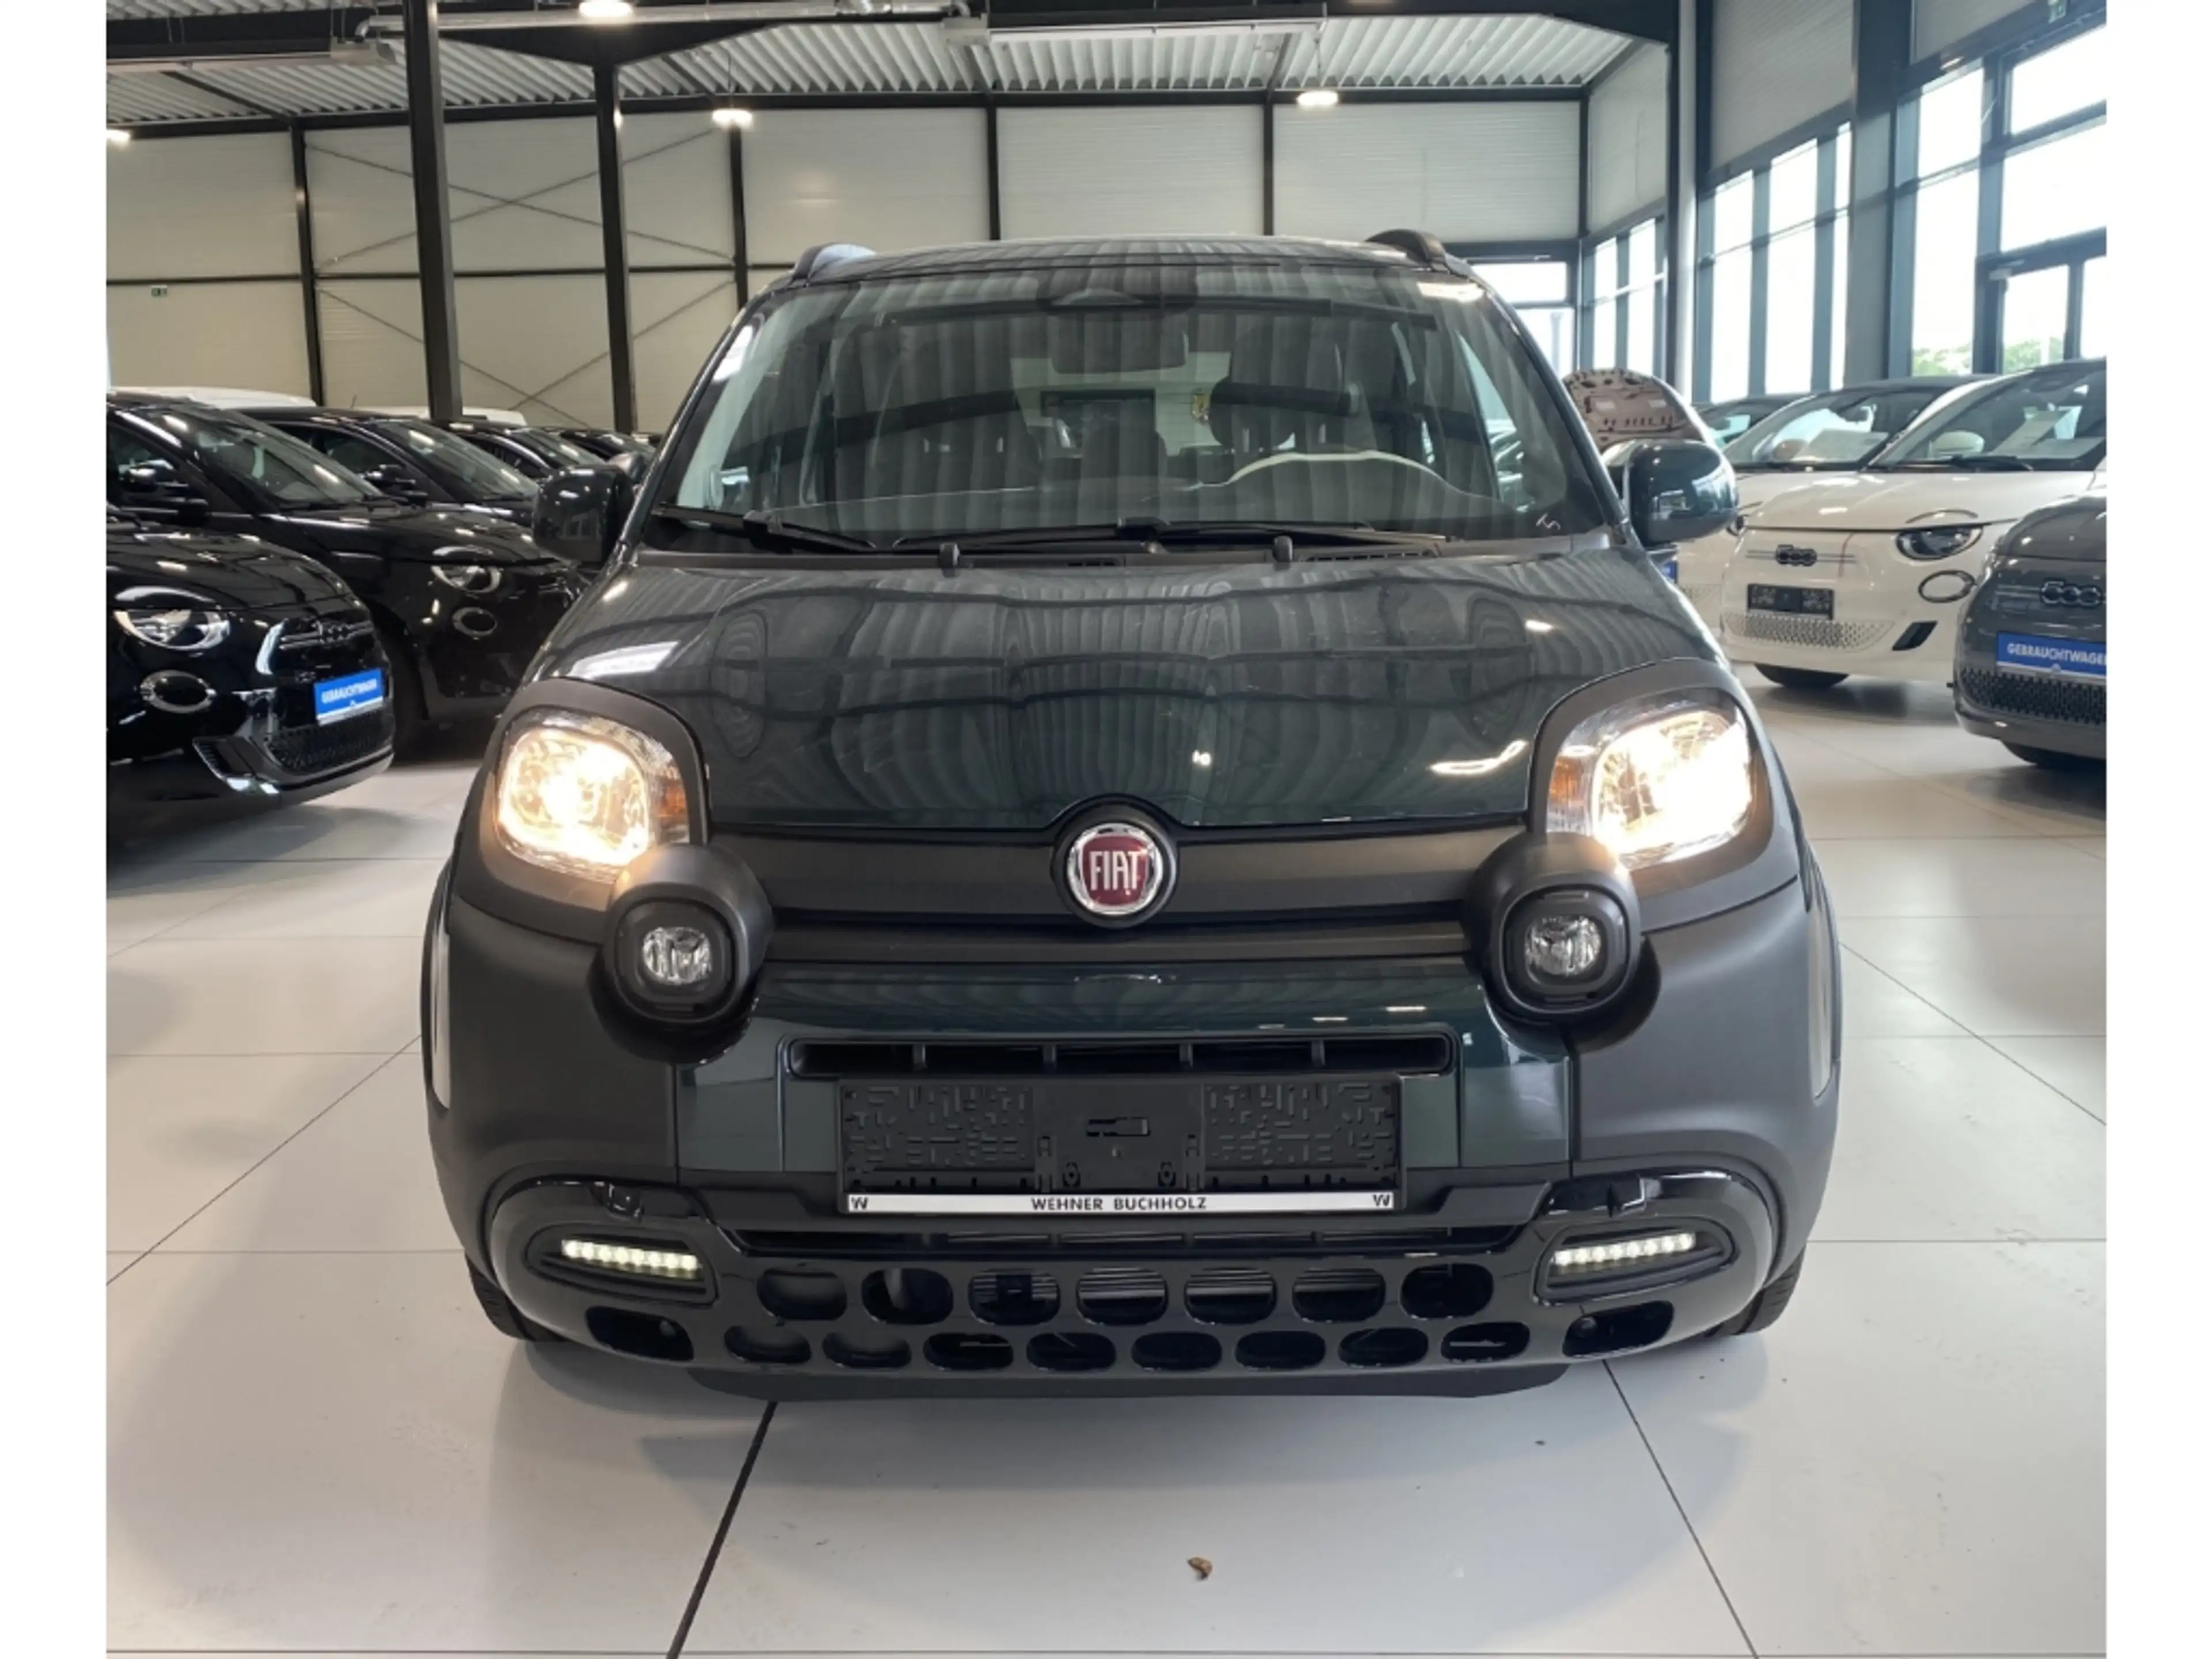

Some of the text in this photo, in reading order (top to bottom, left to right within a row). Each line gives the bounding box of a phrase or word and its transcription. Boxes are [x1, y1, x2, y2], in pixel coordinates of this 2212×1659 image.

[2041, 579, 2102, 607] 500
[1089, 850, 1143, 891] FIAT
[1031, 1197, 1103, 1210] WEHNER
[1113, 1196, 1207, 1210] BUCHHOLZ
